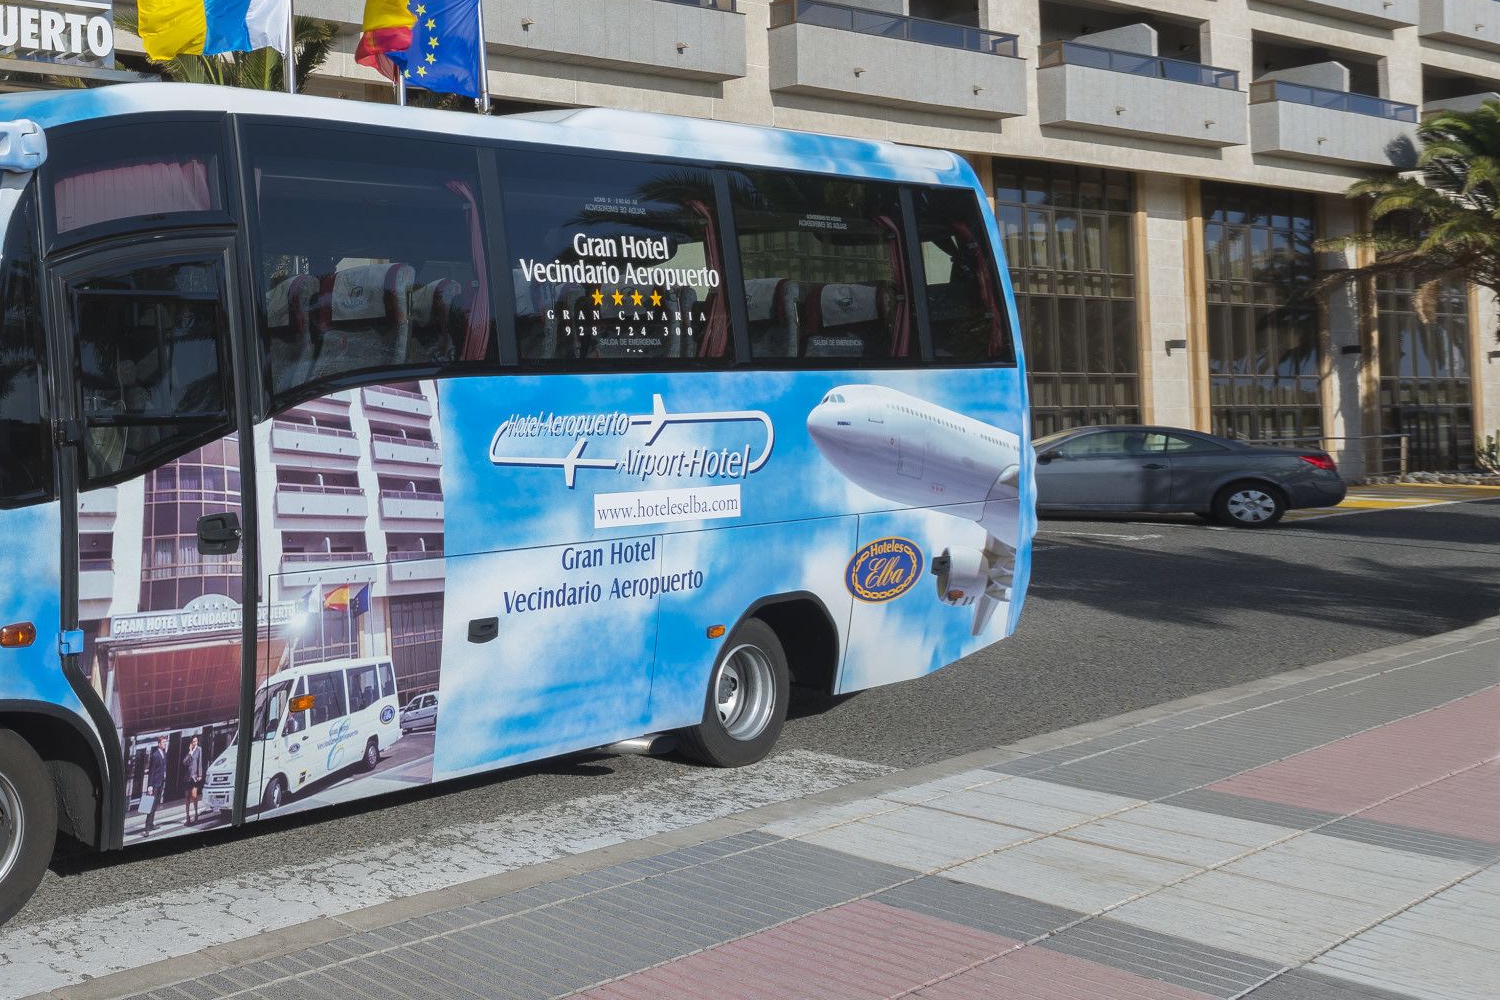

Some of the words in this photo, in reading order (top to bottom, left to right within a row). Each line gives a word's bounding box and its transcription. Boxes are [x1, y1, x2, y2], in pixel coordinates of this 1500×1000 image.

[573, 232, 617, 257] Gran
[621, 235, 670, 260] Hotel
[519, 258, 620, 285] Vecindario
[624, 262, 720, 291] Aeropuerto
[546, 309, 601, 321] GRAN
[618, 310, 707, 322] CANARIA
[565, 326, 598, 337] 928
[615, 326, 647, 337] 724
[663, 326, 693, 337] 300
[597, 496, 739, 521] www.hoteleselba.com
[562, 547, 603, 570] Gran
[610, 537, 656, 565] Hotel
[870, 540, 905, 557] Hoteles
[865, 556, 905, 589] Elba
[503, 581, 601, 615] Vecindario
[609, 569, 704, 601] Aeropuerto
[114, 619, 144, 636] GRAN
